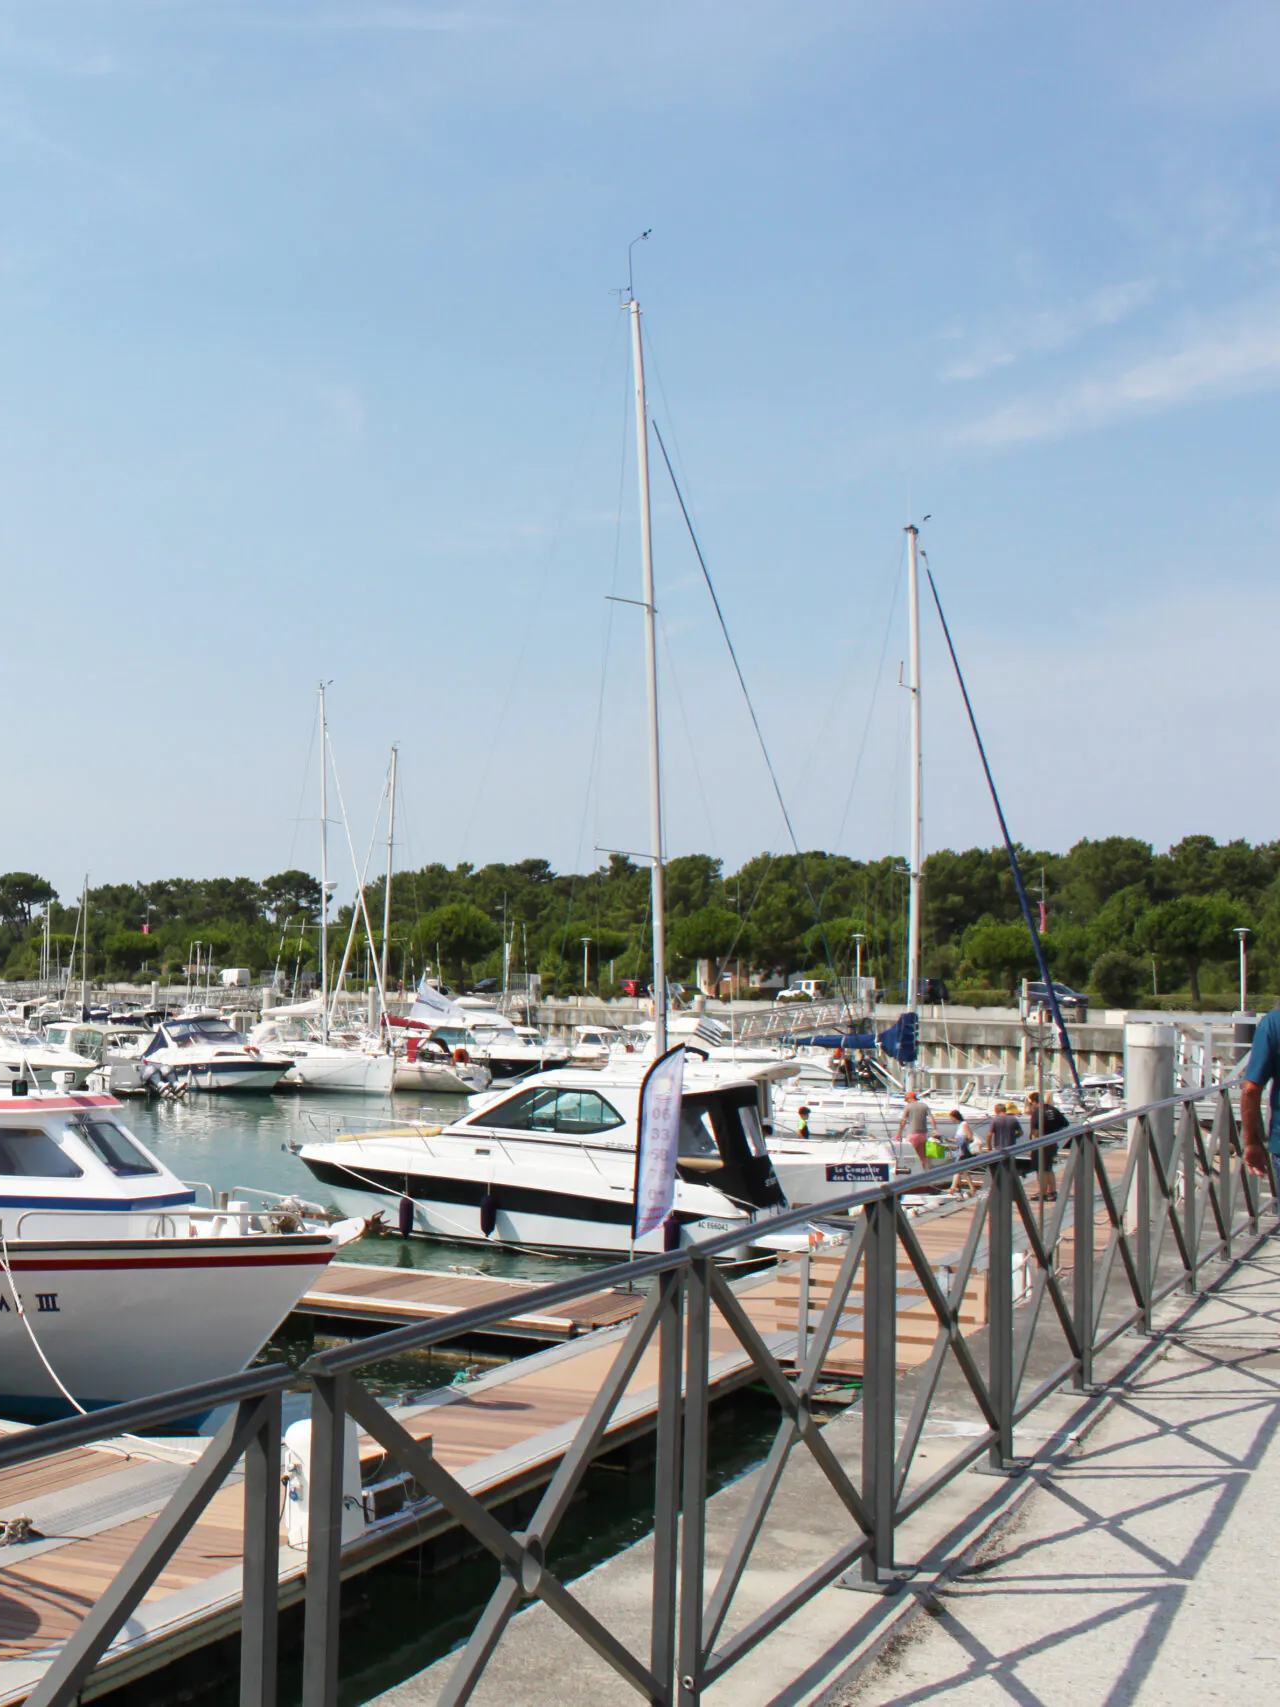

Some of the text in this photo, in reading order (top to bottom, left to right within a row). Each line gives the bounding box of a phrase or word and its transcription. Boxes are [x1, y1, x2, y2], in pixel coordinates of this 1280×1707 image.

[651, 1108, 672, 1120] 06
[651, 1128, 670, 1141] 33
[35, 1292, 61, 1313] III
